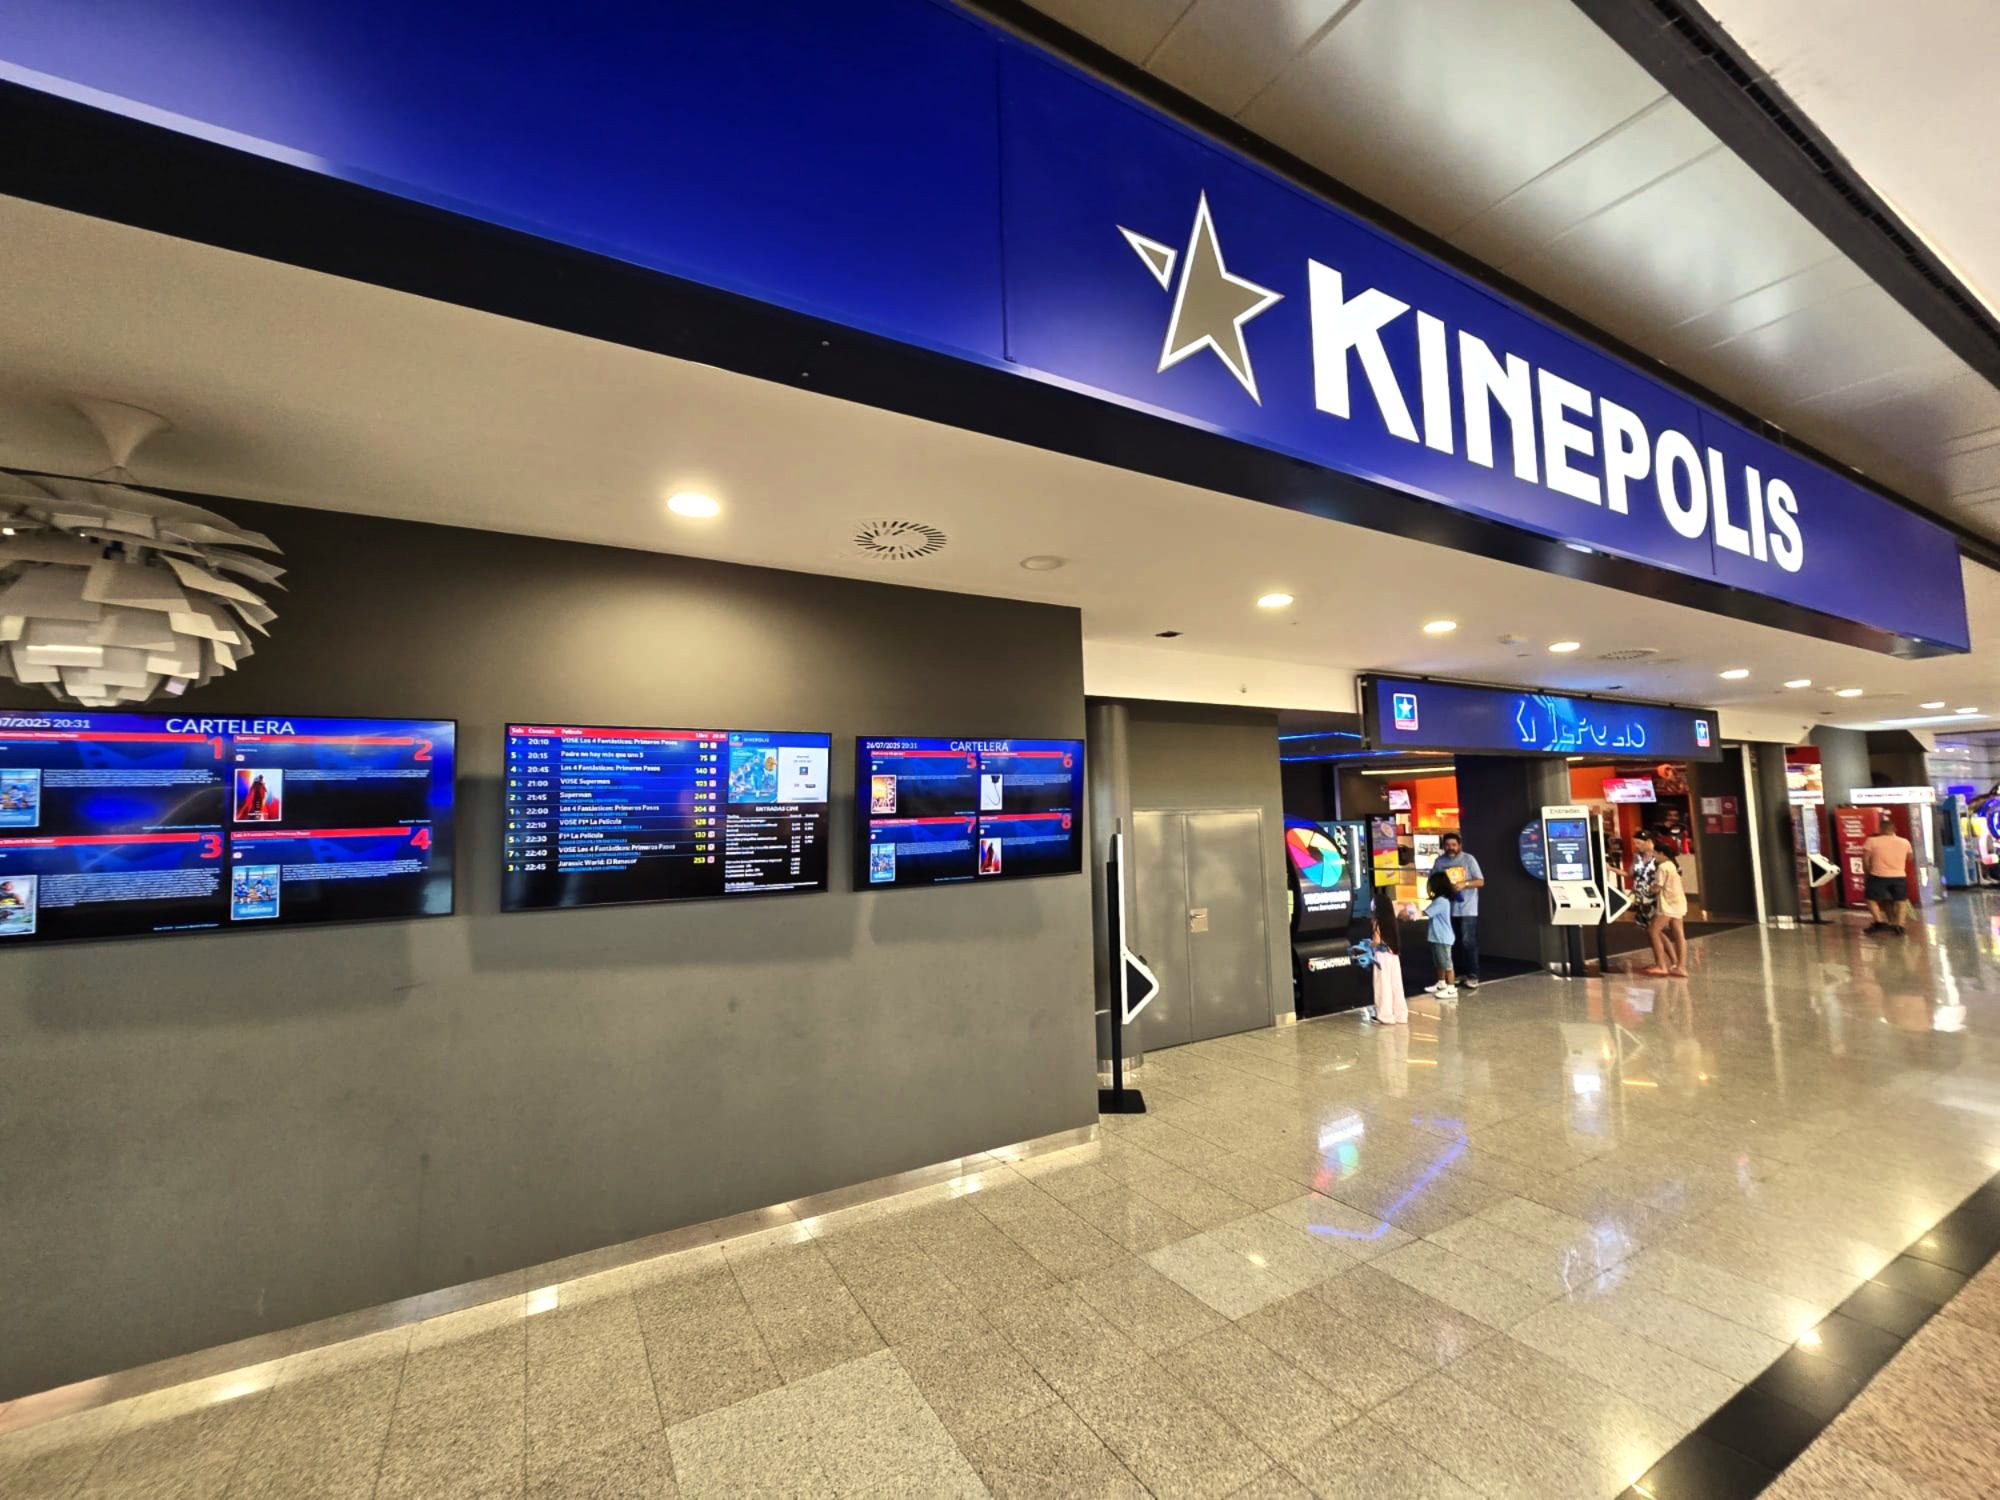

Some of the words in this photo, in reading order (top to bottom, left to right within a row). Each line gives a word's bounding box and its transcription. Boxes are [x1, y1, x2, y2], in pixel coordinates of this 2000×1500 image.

[1309, 259, 1804, 573] KINEPOLIS
[0, 718, 50, 728] 7/2025
[53, 719, 91, 728] 20:31
[166, 718, 295, 734] CARTELERA
[208, 736, 223, 760] 1
[415, 740, 432, 760] 2
[950, 741, 1009, 752] CARTELERA
[967, 752, 977, 769] 5
[1063, 753, 1073, 768] 6
[966, 816, 977, 834] 7
[1062, 813, 1071, 829] 8
[201, 834, 222, 858] 3
[411, 829, 432, 849] 4
